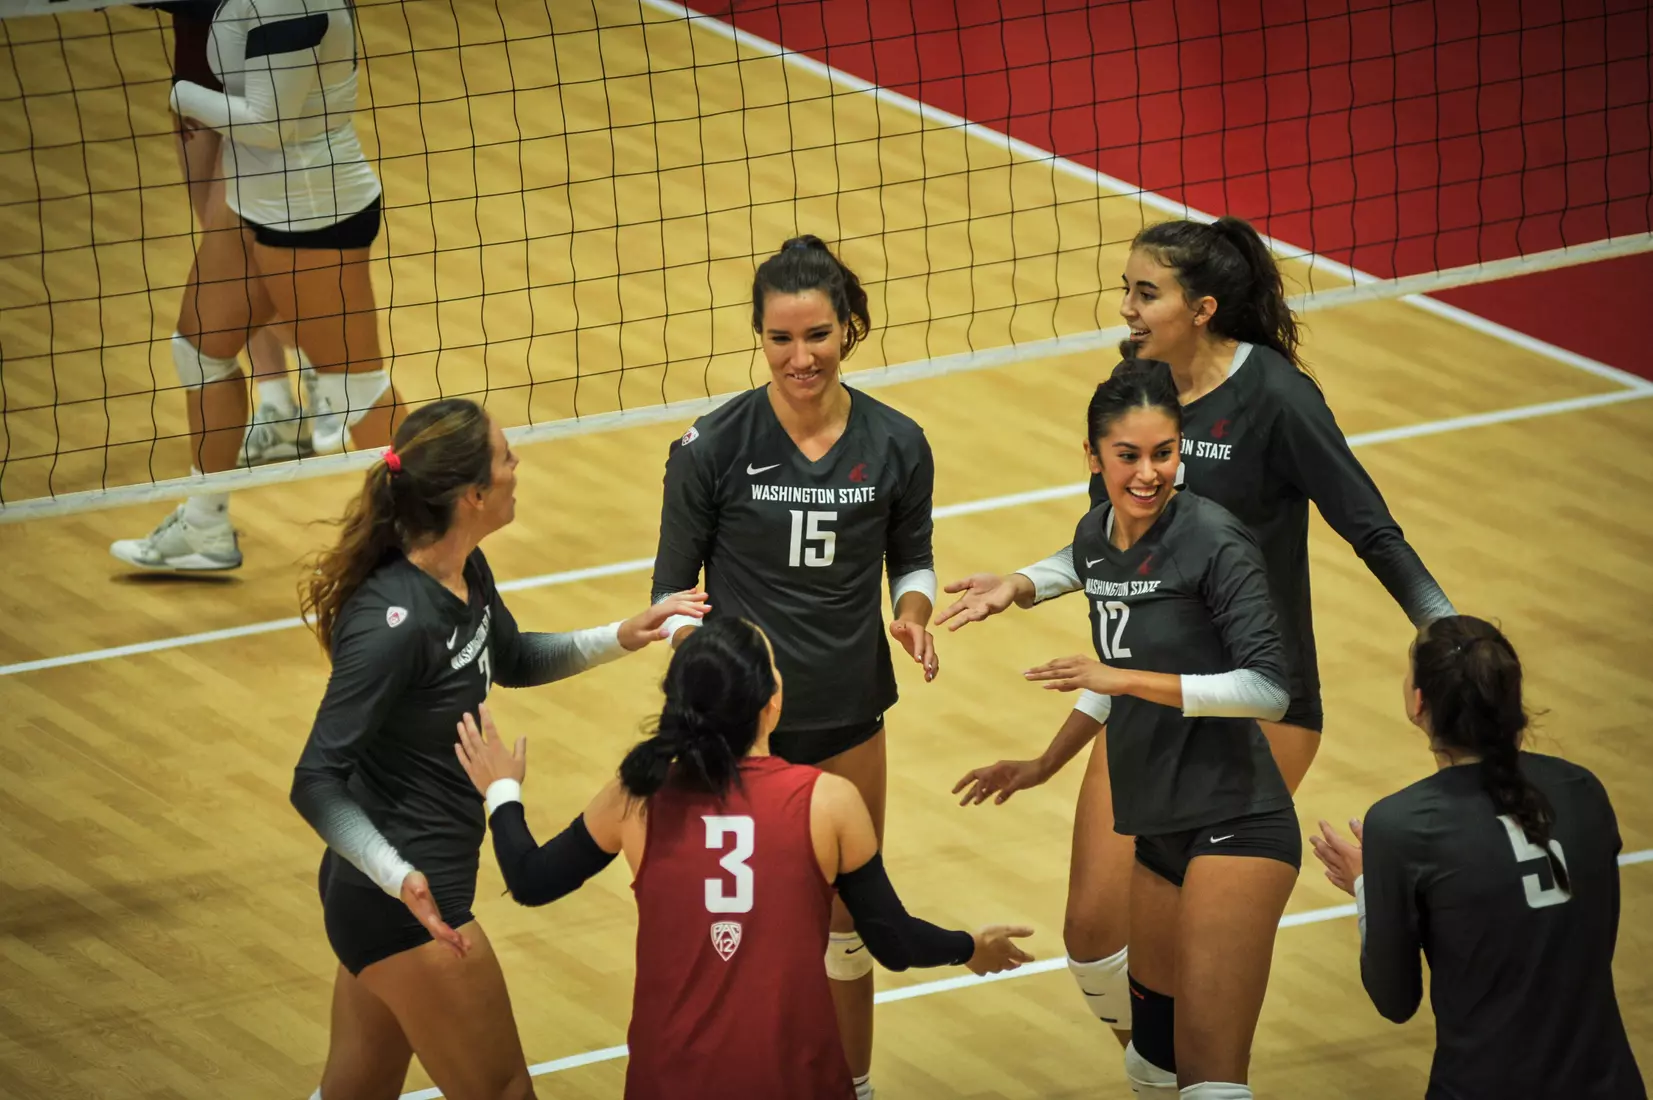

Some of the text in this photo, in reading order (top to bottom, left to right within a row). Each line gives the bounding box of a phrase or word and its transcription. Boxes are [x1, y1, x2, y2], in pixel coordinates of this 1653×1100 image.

[1196, 441, 1232, 460] STATE
[751, 484, 875, 504] WASHINGTON STATE
[789, 510, 838, 567] 15
[1086, 578, 1161, 597] WASHINGTON STATE
[1097, 600, 1132, 659] 12
[700, 815, 755, 913] 3
[1496, 814, 1571, 908] 5
[713, 924, 740, 944] PAC
[720, 938, 734, 953] 12
